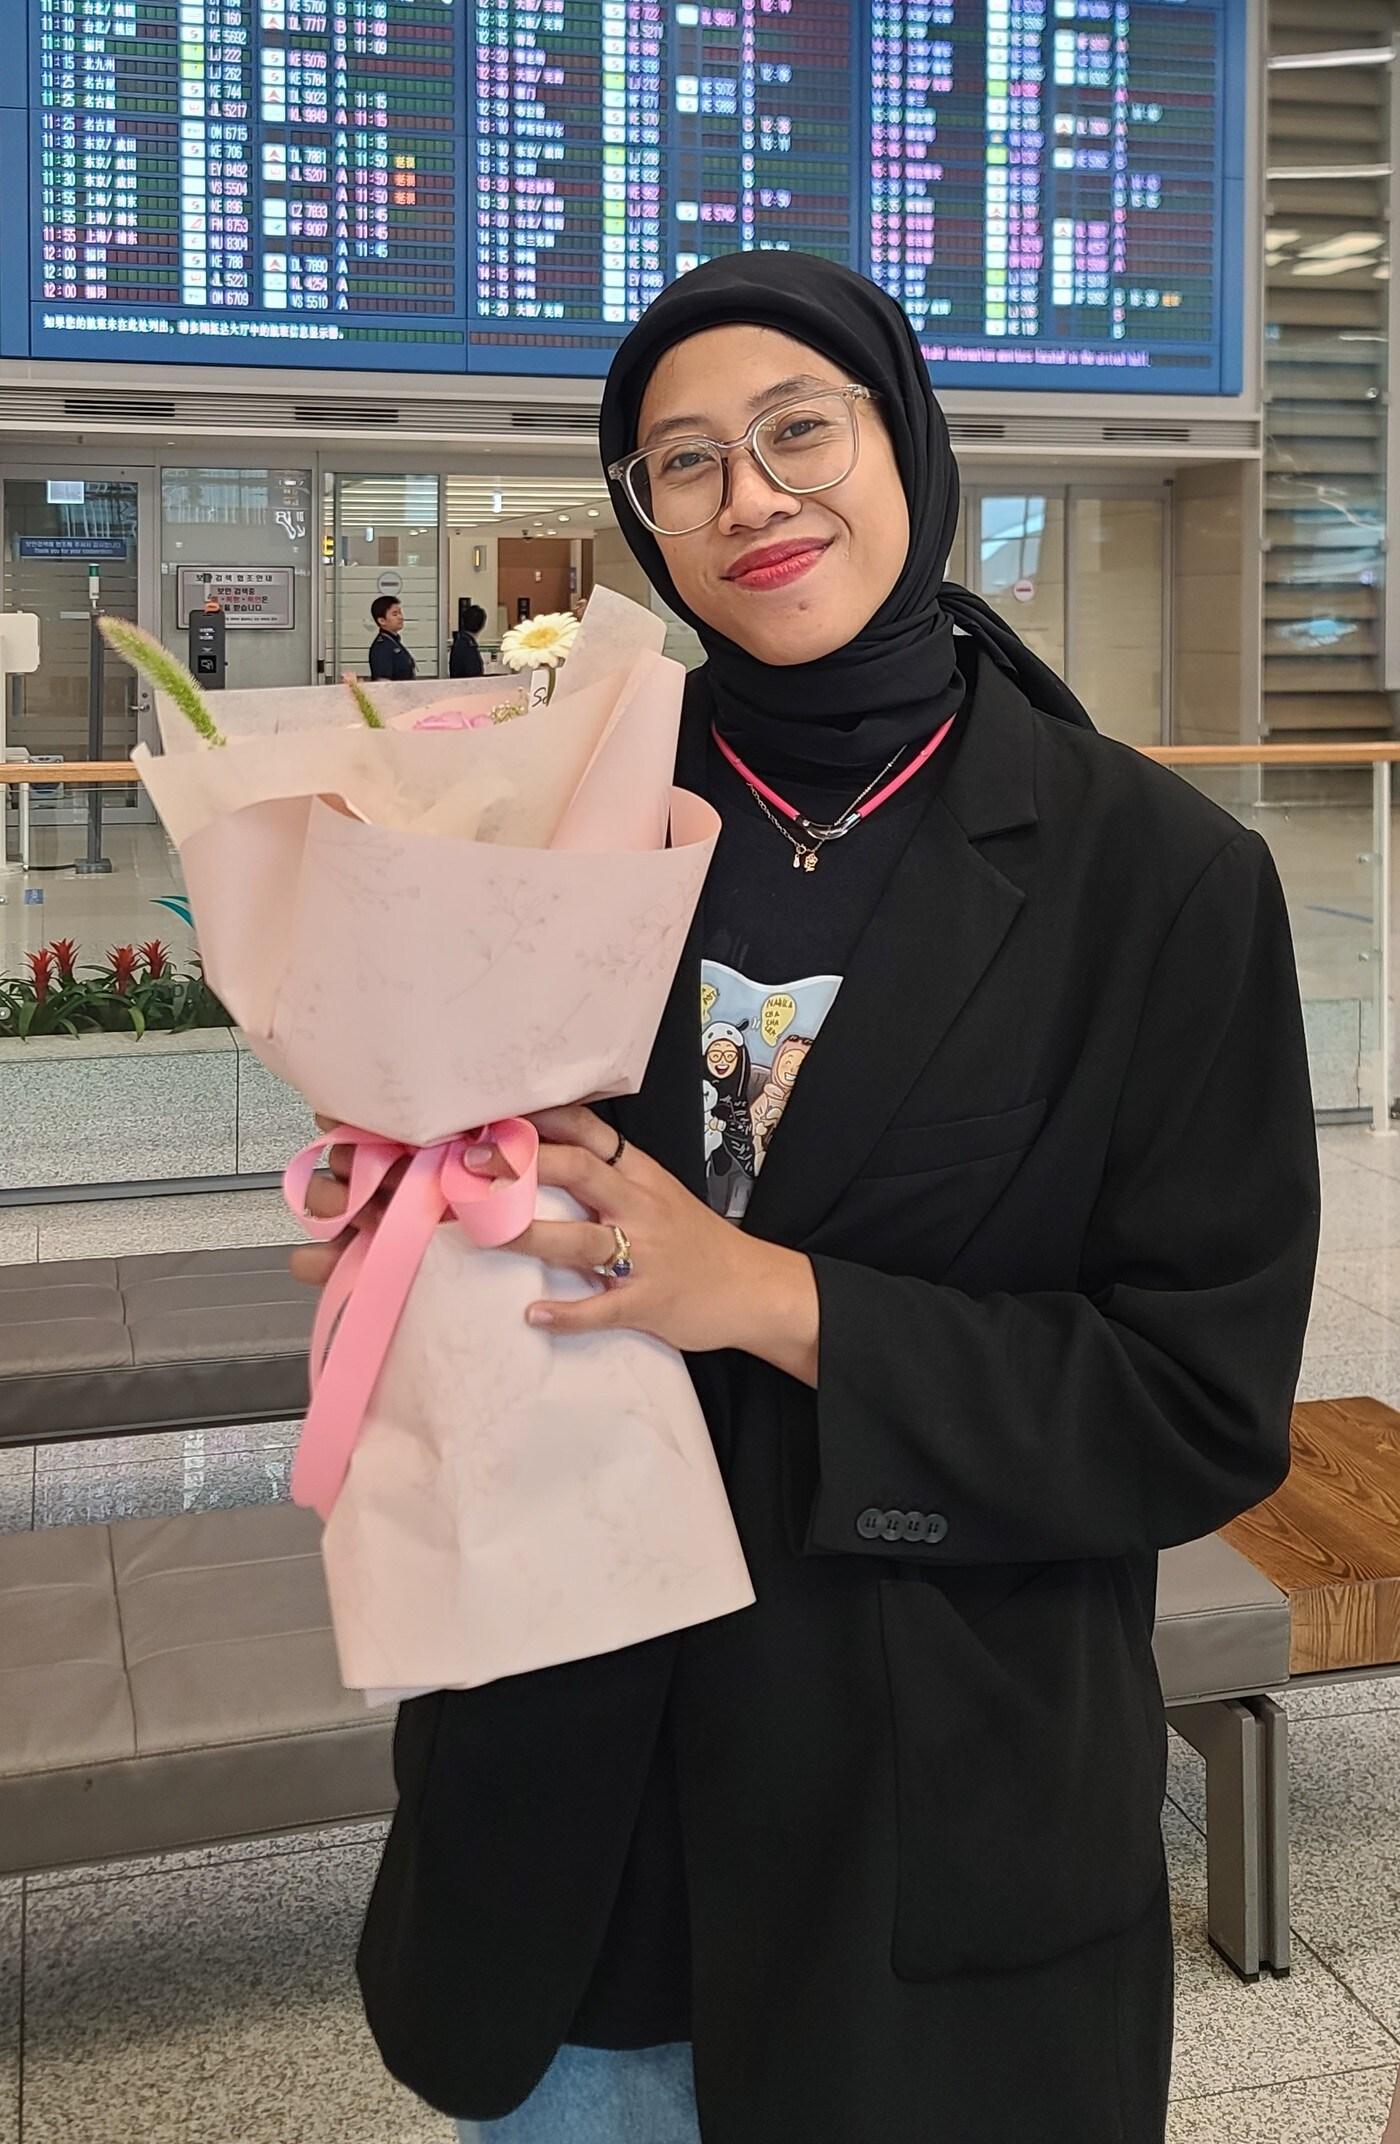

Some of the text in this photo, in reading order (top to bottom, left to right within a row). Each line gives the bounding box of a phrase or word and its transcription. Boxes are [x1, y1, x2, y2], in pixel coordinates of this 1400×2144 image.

[41, 0, 75, 14] 11:10
[209, 10, 221, 24] CI
[223, 10, 241, 26] 160
[334, 16, 347, 34] B
[354, 19, 387, 37] 11:09
[334, 1, 347, 16] B
[353, 1, 387, 18] 11:08
[41, 15, 387, 55] 11:10 KE 5692 B 11:09
[41, 34, 75, 51] 11:10
[209, 46, 221, 62] LJ
[223, 47, 242, 63] 222
[334, 53, 347, 70] A
[42, 53, 75, 69] 11:15
[209, 64, 222, 79] LJ
[223, 66, 242, 81] 262
[334, 72, 347, 89] A
[42, 72, 75, 88] 11:25
[209, 82, 222, 98] KE
[223, 84, 242, 100] 744
[335, 90, 347, 106] A
[354, 91, 388, 109] 11:15
[42, 90, 75, 107] 11:25
[209, 101, 222, 116] JL
[223, 102, 247, 118] 5217
[335, 108, 347, 125] A
[354, 109, 388, 128] 11:15
[42, 114, 76, 130] 11:25
[209, 123, 222, 140] OM
[223, 124, 248, 141] 6715
[335, 130, 348, 148] A
[354, 132, 388, 149] 11:15
[42, 133, 76, 150] 11:30
[210, 144, 222, 158] KE
[224, 144, 242, 160] 706
[335, 148, 348, 166] A
[354, 150, 388, 168] 11:50
[42, 152, 76, 168] 11:30
[210, 162, 222, 176] EY
[224, 163, 248, 178] 8492
[335, 167, 348, 184] A
[354, 169, 388, 186] 11:50
[42, 170, 76, 187] 11:30
[210, 180, 222, 194] VS
[224, 181, 248, 196] 5504
[335, 185, 348, 202] A
[355, 186, 388, 204] 11:50
[42, 188, 76, 205] 11:55
[210, 198, 222, 213] KE
[335, 203, 348, 220] A
[355, 204, 388, 222] 11:45
[42, 207, 76, 224] 11:55
[336, 221, 348, 238] A
[355, 223, 388, 240] 11:45
[43, 226, 77, 242] 11:55
[224, 236, 248, 251] 8304
[336, 239, 348, 256] A
[355, 240, 388, 258] 11:45
[43, 245, 77, 261] 12:00
[210, 252, 223, 268] KE
[336, 258, 348, 274] A
[43, 264, 77, 280] 12:00
[210, 272, 223, 286] JL
[336, 275, 348, 292] A
[43, 282, 77, 298] 12:00
[210, 289, 223, 305] OM
[224, 290, 249, 306] 6709
[336, 293, 348, 310] A
